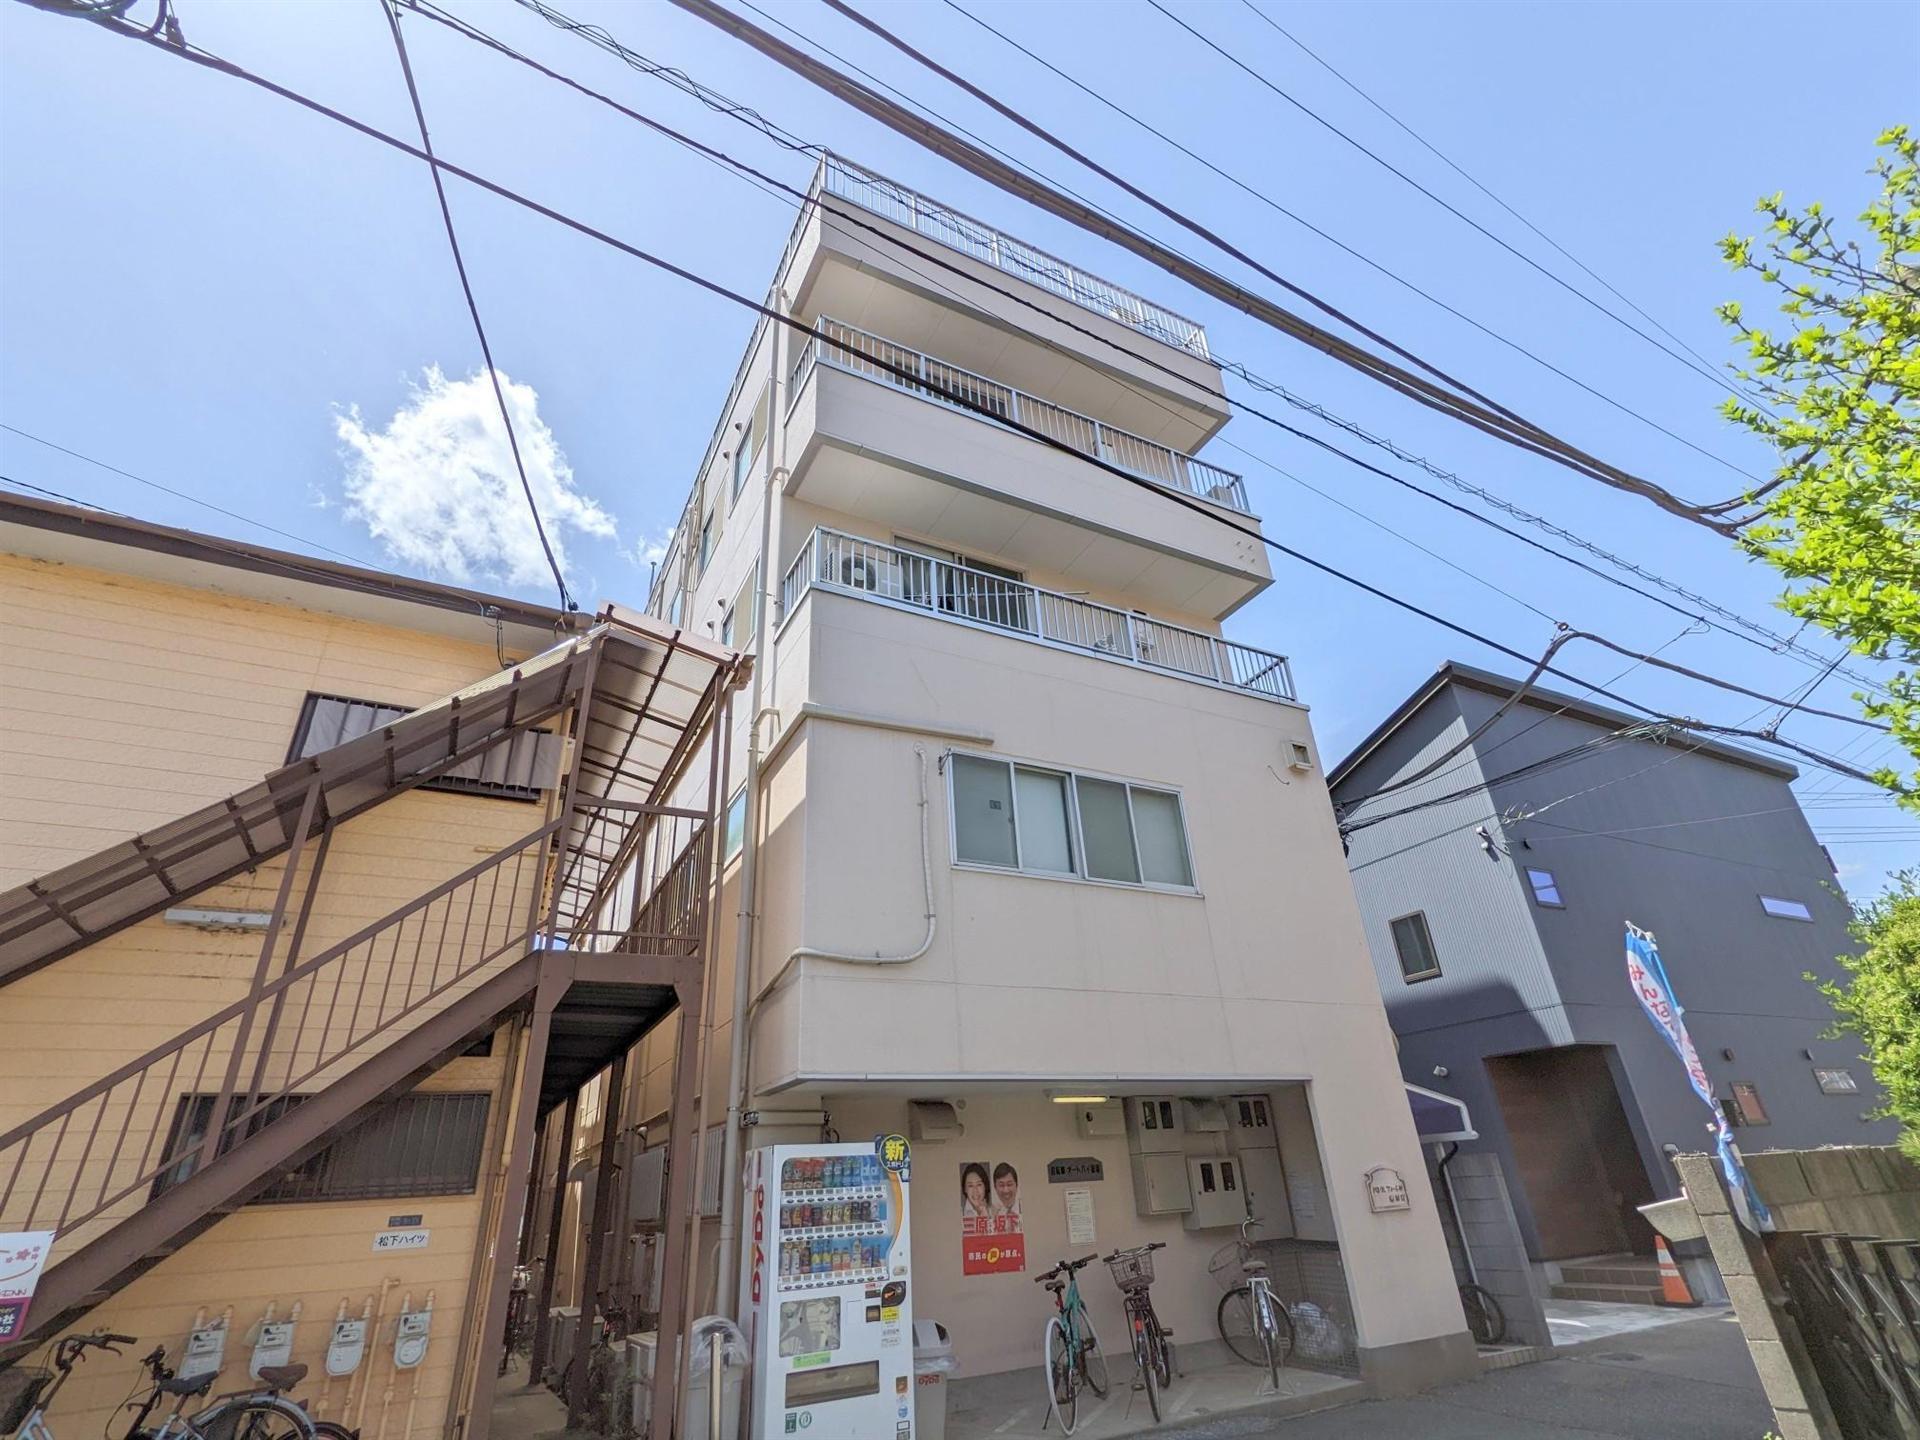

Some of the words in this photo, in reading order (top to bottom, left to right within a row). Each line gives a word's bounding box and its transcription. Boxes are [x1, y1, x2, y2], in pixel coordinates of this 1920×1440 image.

[885, 1139, 905, 1161] 新
[962, 1215, 988, 1234] 三原
[994, 1213, 1019, 1233] 坂下
